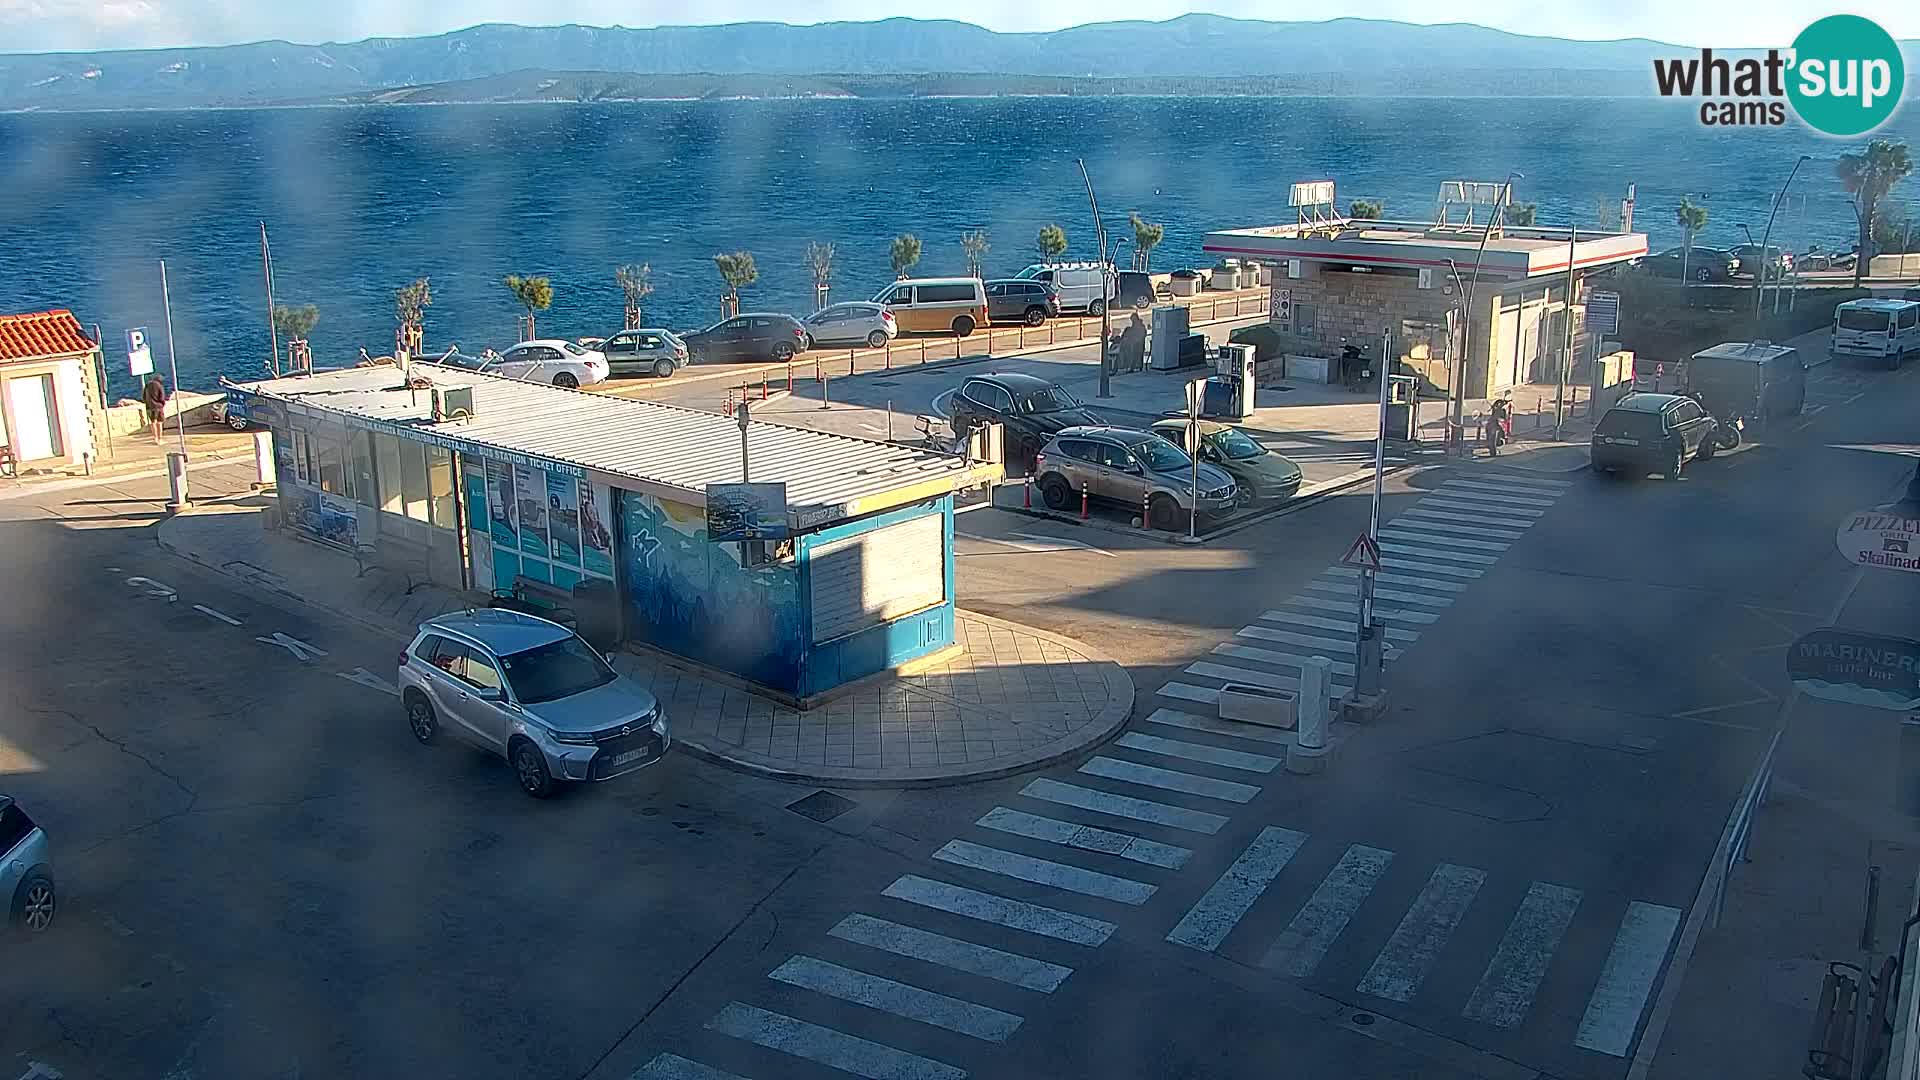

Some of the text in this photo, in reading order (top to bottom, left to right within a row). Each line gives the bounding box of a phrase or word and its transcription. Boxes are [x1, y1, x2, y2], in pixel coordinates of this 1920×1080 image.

[131, 330, 145, 351] P
[438, 438, 468, 451] POSTAJA
[479, 446, 494, 458] BUS
[495, 451, 527, 464] STATION
[529, 457, 555, 472] TICKET
[556, 463, 583, 478] OFFICE
